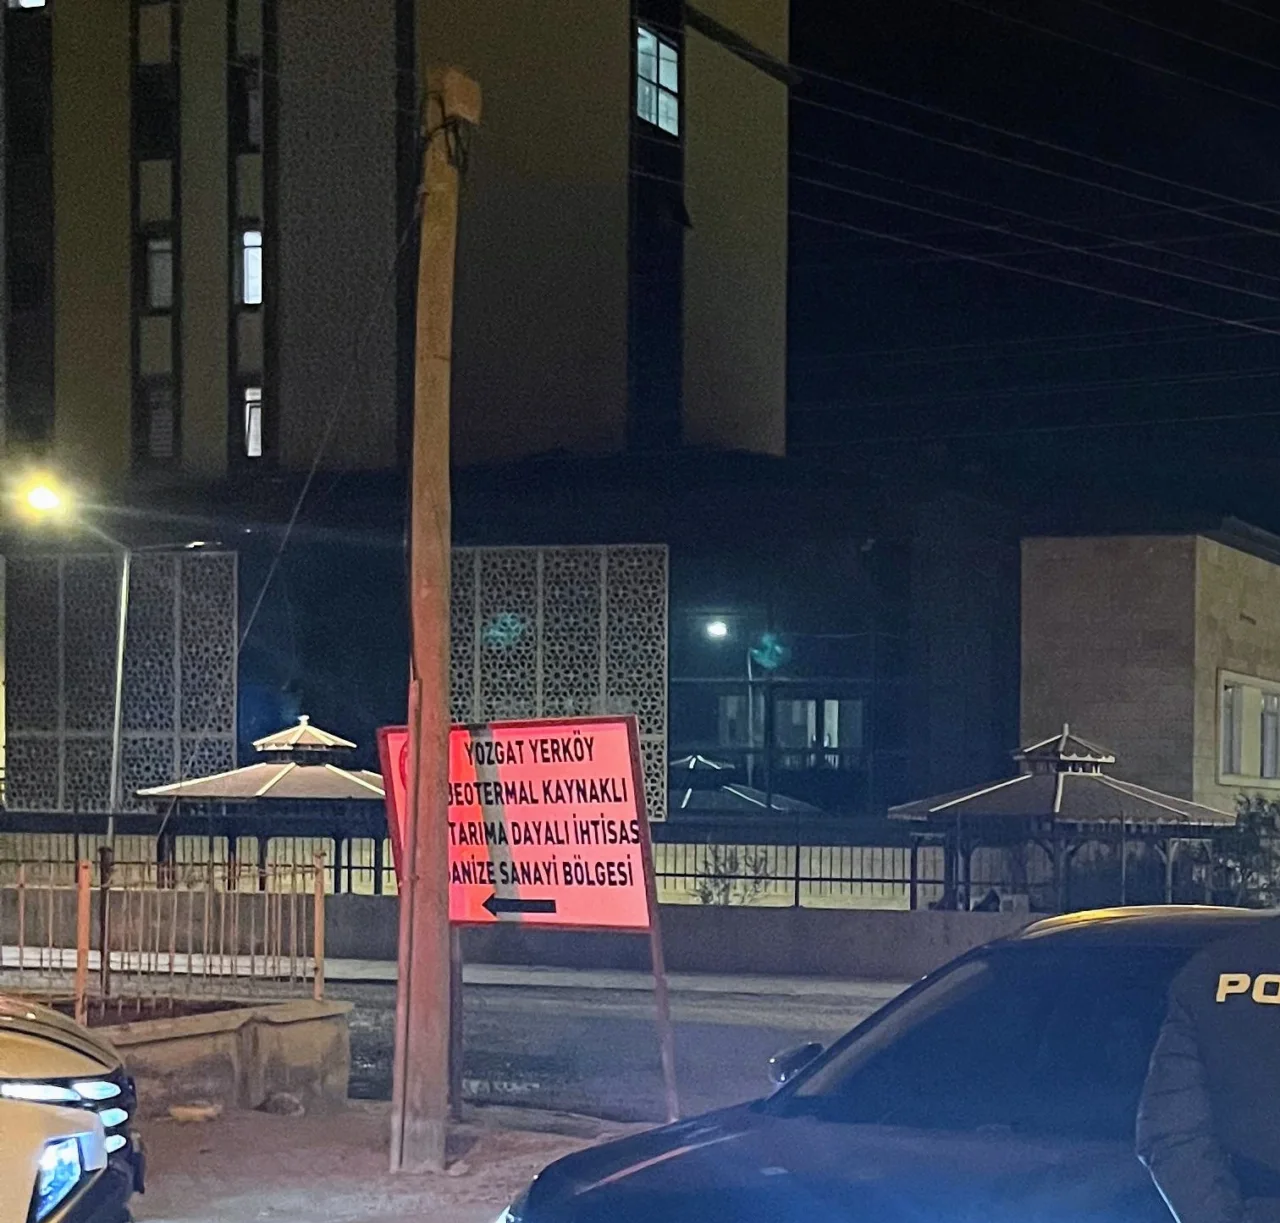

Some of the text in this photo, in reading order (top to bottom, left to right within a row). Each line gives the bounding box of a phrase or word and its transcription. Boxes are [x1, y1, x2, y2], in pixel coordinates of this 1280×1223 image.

[464, 730, 594, 765] YOZGAT YERKÖY
[543, 777, 628, 804] KAYNAKLI
[448, 812, 640, 846] TARIMA DAYALI İHTİSAS
[448, 854, 633, 886] ANİZE SANAYİ BÖLGESİ
